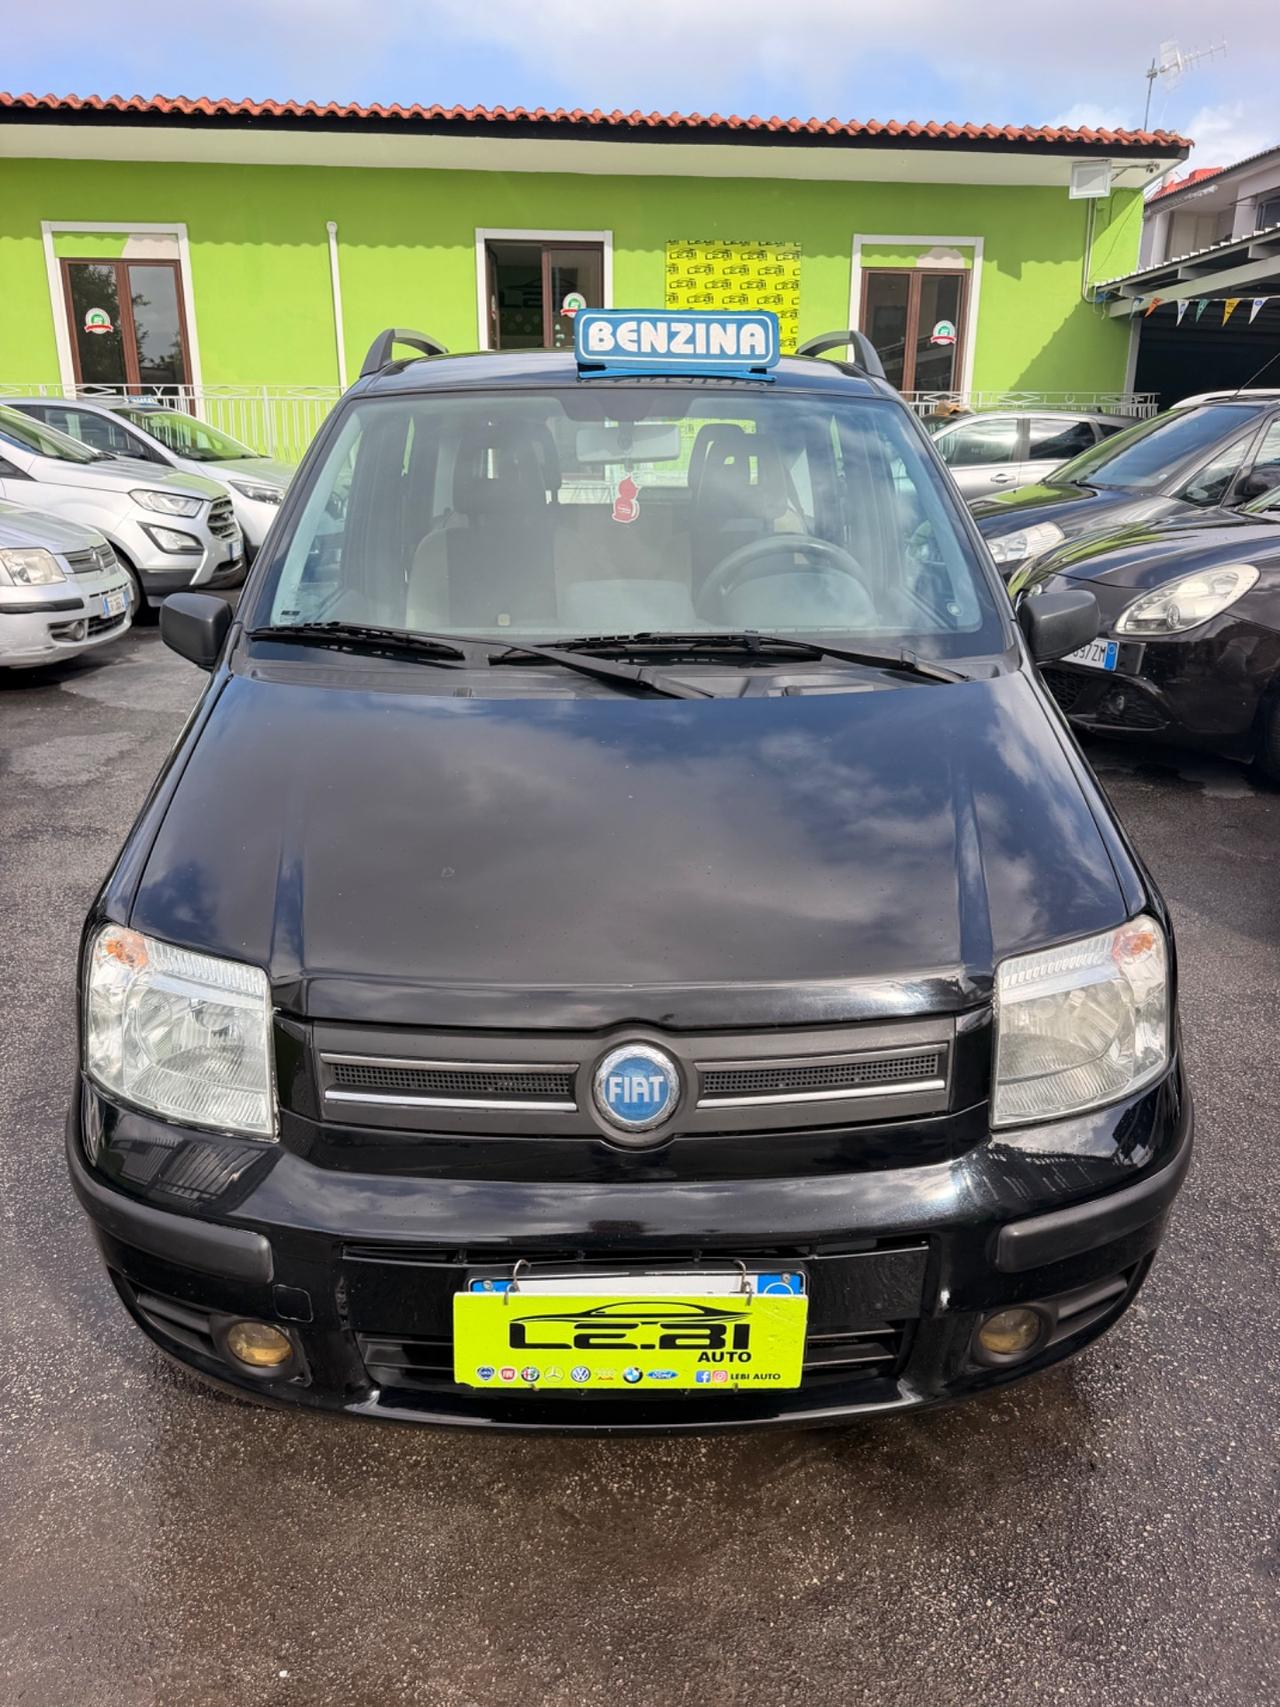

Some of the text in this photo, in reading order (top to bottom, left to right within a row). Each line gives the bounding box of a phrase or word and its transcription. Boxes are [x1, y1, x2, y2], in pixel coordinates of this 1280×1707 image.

[588, 321, 766, 355] BENZINA
[609, 1075, 664, 1104] FIAT
[697, 1351, 751, 1363] AUTO
